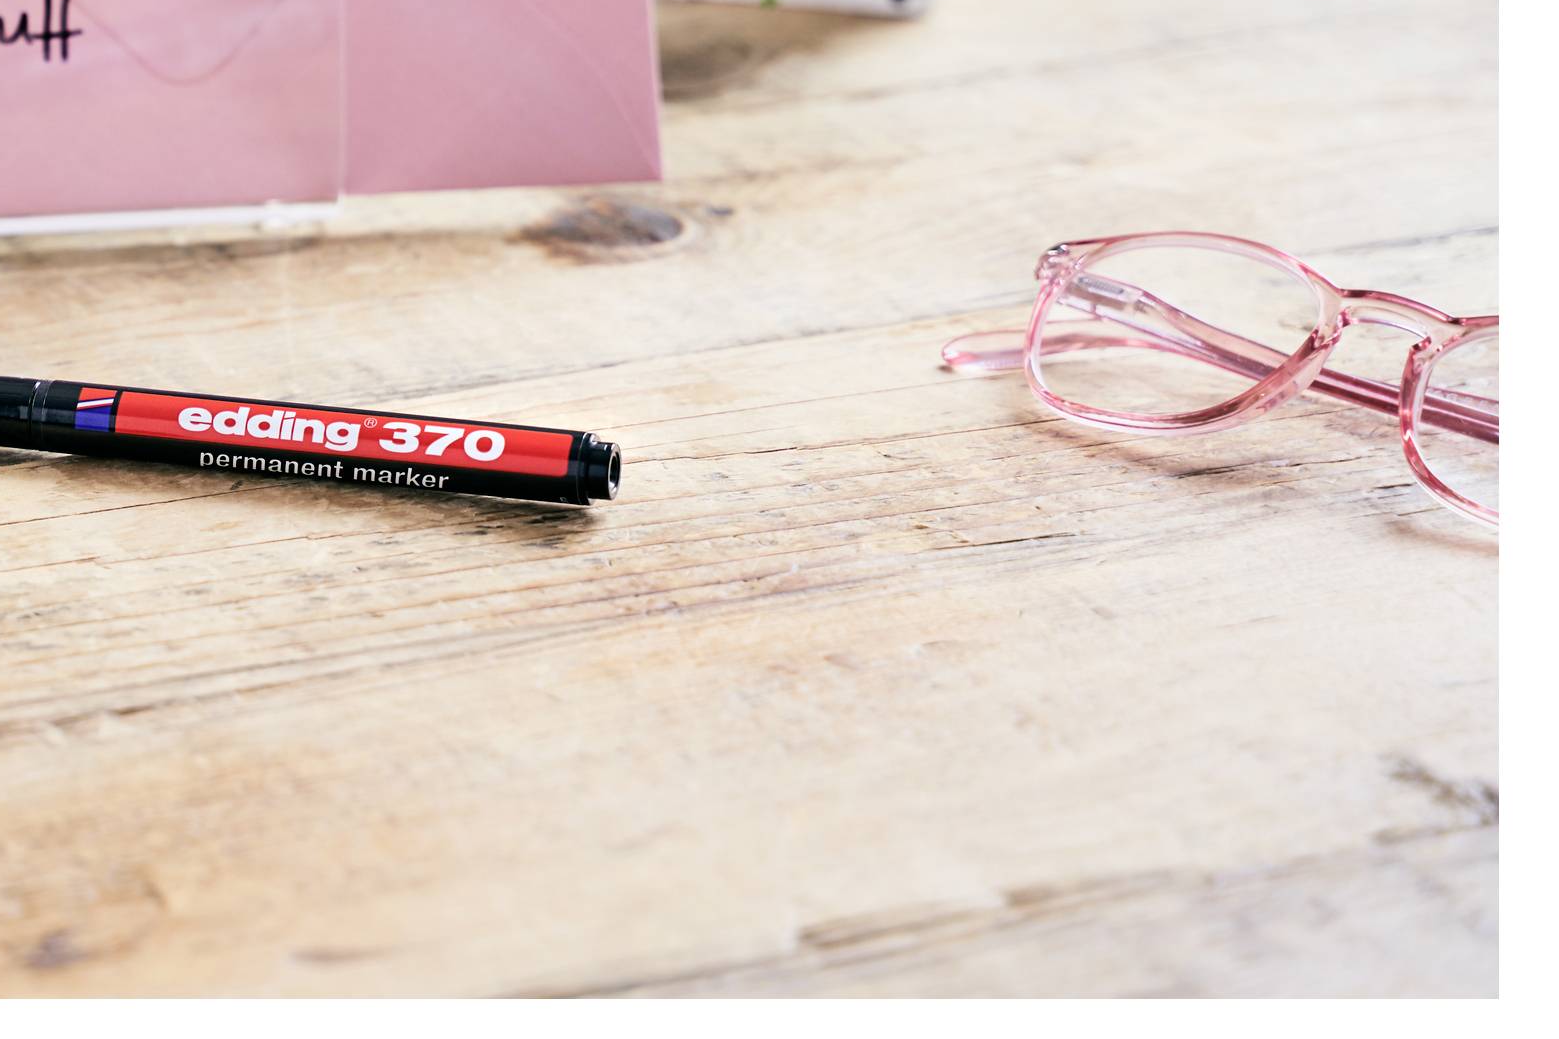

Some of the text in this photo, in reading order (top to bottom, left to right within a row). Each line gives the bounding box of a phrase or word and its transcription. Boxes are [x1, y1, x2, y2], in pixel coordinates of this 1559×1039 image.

[378, 421, 506, 461] 370
[199, 451, 450, 489] permanent marker
